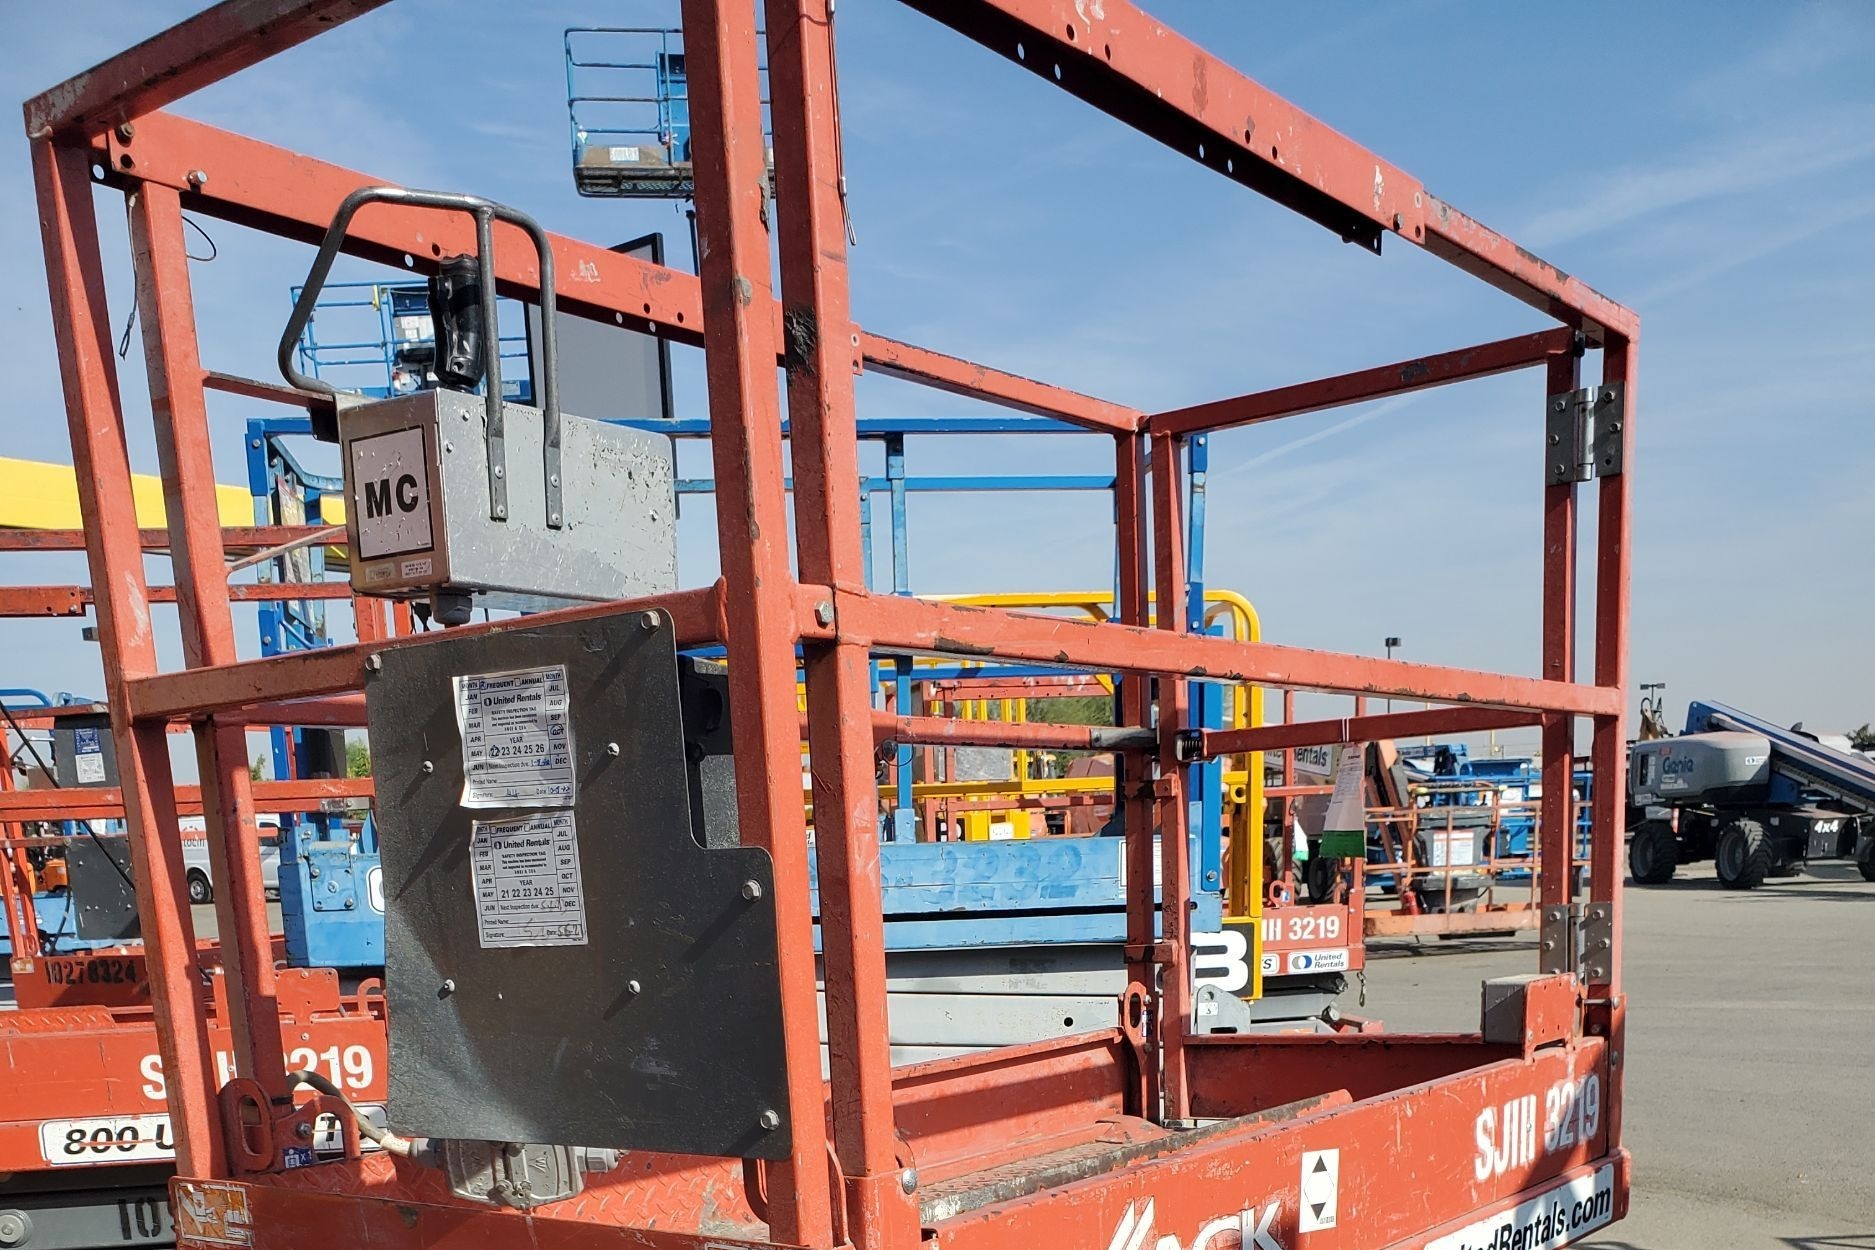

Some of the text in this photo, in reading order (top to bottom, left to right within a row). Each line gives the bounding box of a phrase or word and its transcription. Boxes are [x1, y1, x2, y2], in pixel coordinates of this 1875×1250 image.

[364, 473, 419, 519] MC
[486, 677, 543, 689] FREQUENT ANNUAL
[549, 684, 560, 692] JUL
[493, 692, 542, 706] United Rentals
[509, 736, 524, 744] YEAR
[501, 746, 511, 756] 23
[512, 745, 522, 755] 24
[523, 744, 533, 754] 25
[535, 743, 545, 754] 26
[553, 743, 566, 751] NOV
[555, 757, 567, 765] DEC
[1293, 745, 1328, 768] entals
[472, 763, 484, 771] JUN
[1662, 756, 1694, 774] Genie
[496, 822, 550, 833] FREQUENT ANNUAL
[1814, 820, 1839, 833] 4x4
[557, 830, 568, 838] JUL
[503, 838, 550, 849] United Rentals
[557, 844, 571, 852] AUG
[561, 872, 573, 880] OCT
[501, 886, 554, 898] 21 22 23 24 25
[1288, 916, 1339, 940] 3219
[1314, 953, 1342, 961] United
[283, 1045, 373, 1091] 219
[1545, 1074, 1600, 1151] 3219
